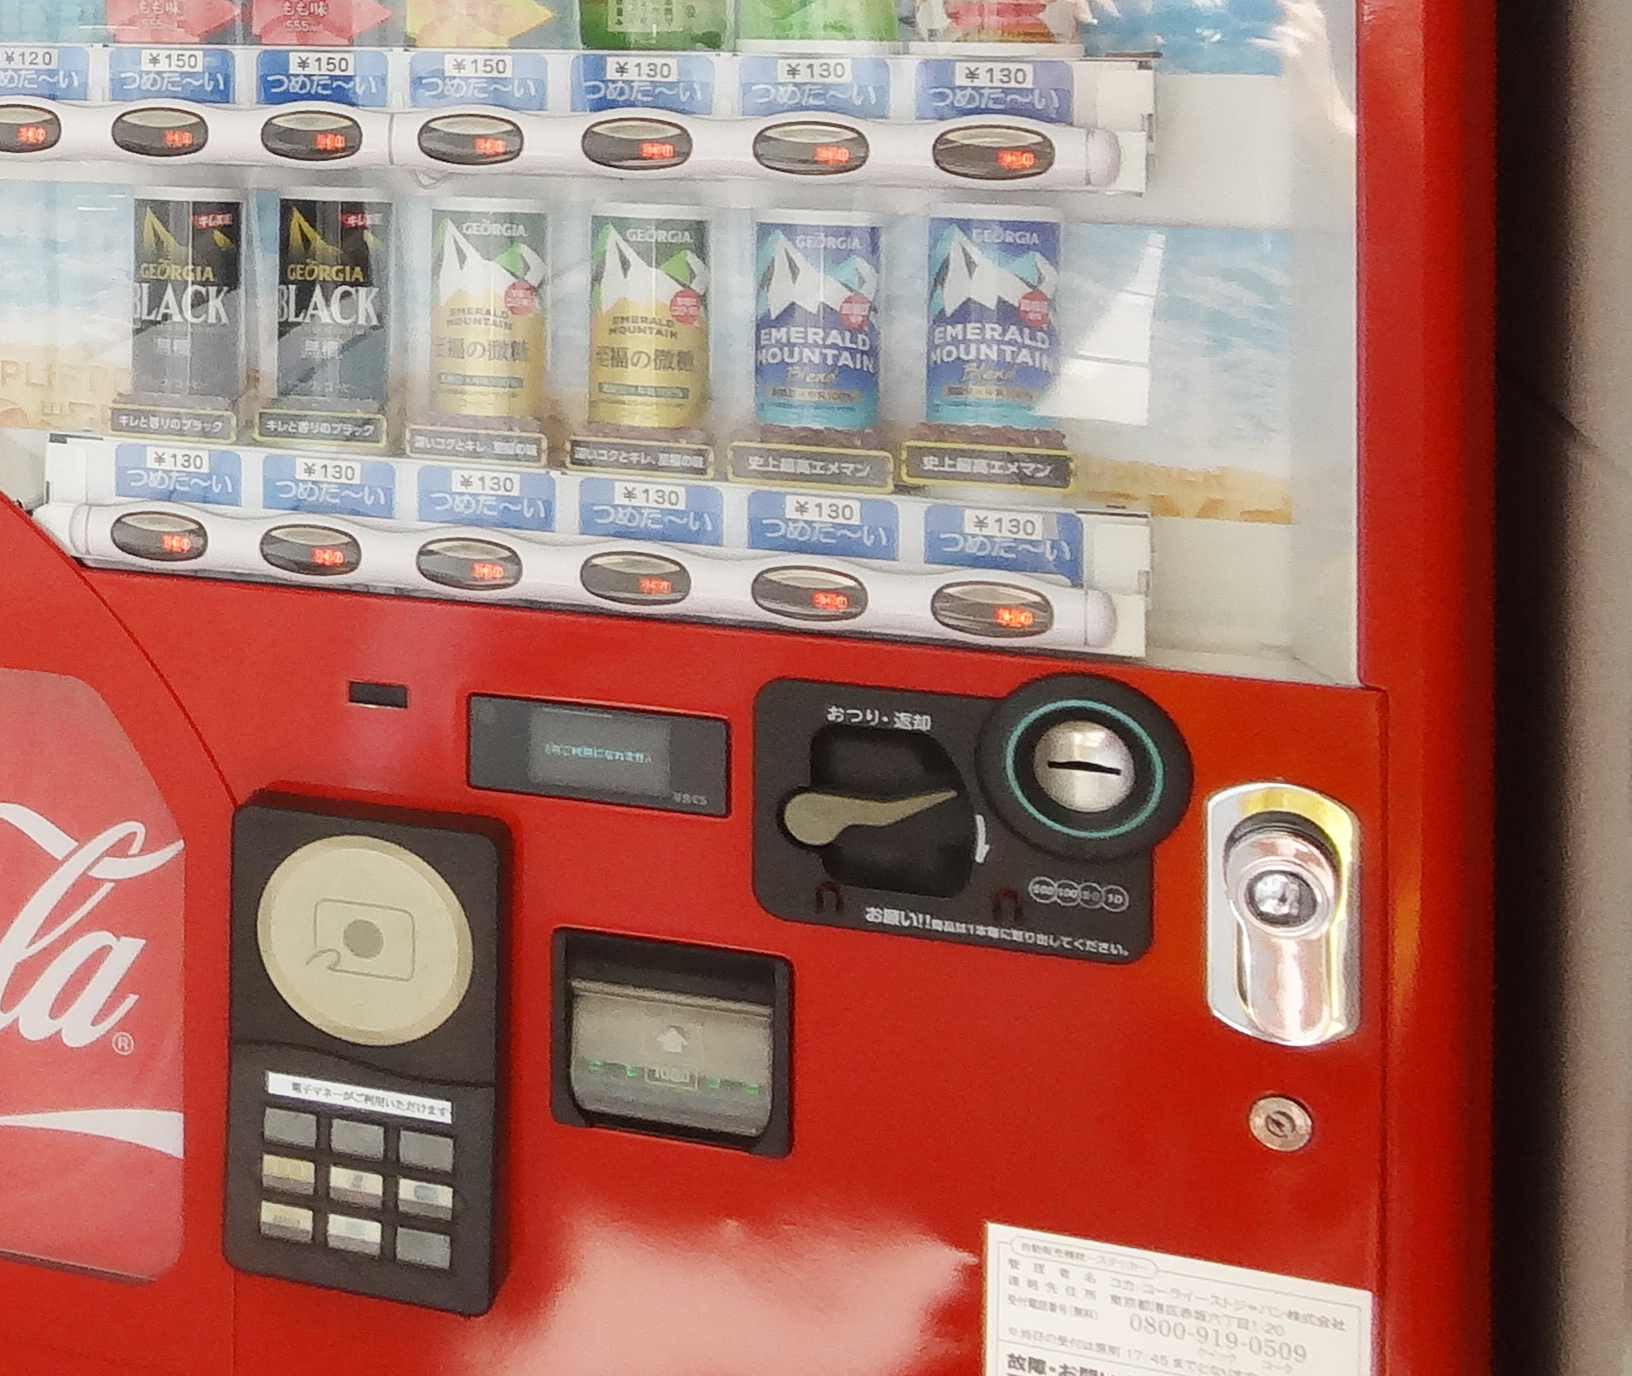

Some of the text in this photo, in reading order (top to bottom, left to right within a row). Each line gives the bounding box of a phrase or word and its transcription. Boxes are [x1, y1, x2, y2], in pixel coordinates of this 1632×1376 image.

[138, 0, 183, 16] もも味
[282, 0, 329, 16] もも味
[4, 50, 53, 66] ¥120
[148, 52, 198, 70] ¥150
[296, 55, 350, 73] ¥150
[451, 57, 508, 75] ¥150
[614, 61, 672, 79] ¥130
[785, 62, 847, 80] ¥130
[964, 66, 1028, 85] ¥130
[462, 219, 528, 237] GEORGIA
[625, 226, 693, 243] GEORGIA
[971, 226, 1040, 245] GEORGIA
[795, 231, 862, 250] GEORGIA
[140, 258, 215, 282] GEORGIA
[287, 258, 365, 282] GEORGIA
[277, 285, 380, 326] BLACK
[759, 325, 871, 352] EMERALD
[934, 322, 1050, 349] EMERALD
[757, 347, 875, 373] MOUNTAIN
[932, 344, 1054, 374] MOUNTAIN
[153, 451, 204, 470] ¥130
[747, 456, 872, 476] 史上最高エメマン
[921, 455, 1054, 478] 史上最高エメマン
[302, 463, 356, 481] ¥130
[458, 475, 515, 493] ¥130
[621, 488, 680, 507] ¥130
[794, 501, 854, 521] ¥130
[973, 515, 1036, 536] ¥130
[826, 705, 932, 733] おつり・返却
[291, 1081, 450, 1118] 電子マネーがご利用いただけます
[1129, 1313, 1308, 1364] 0800-919-0509
